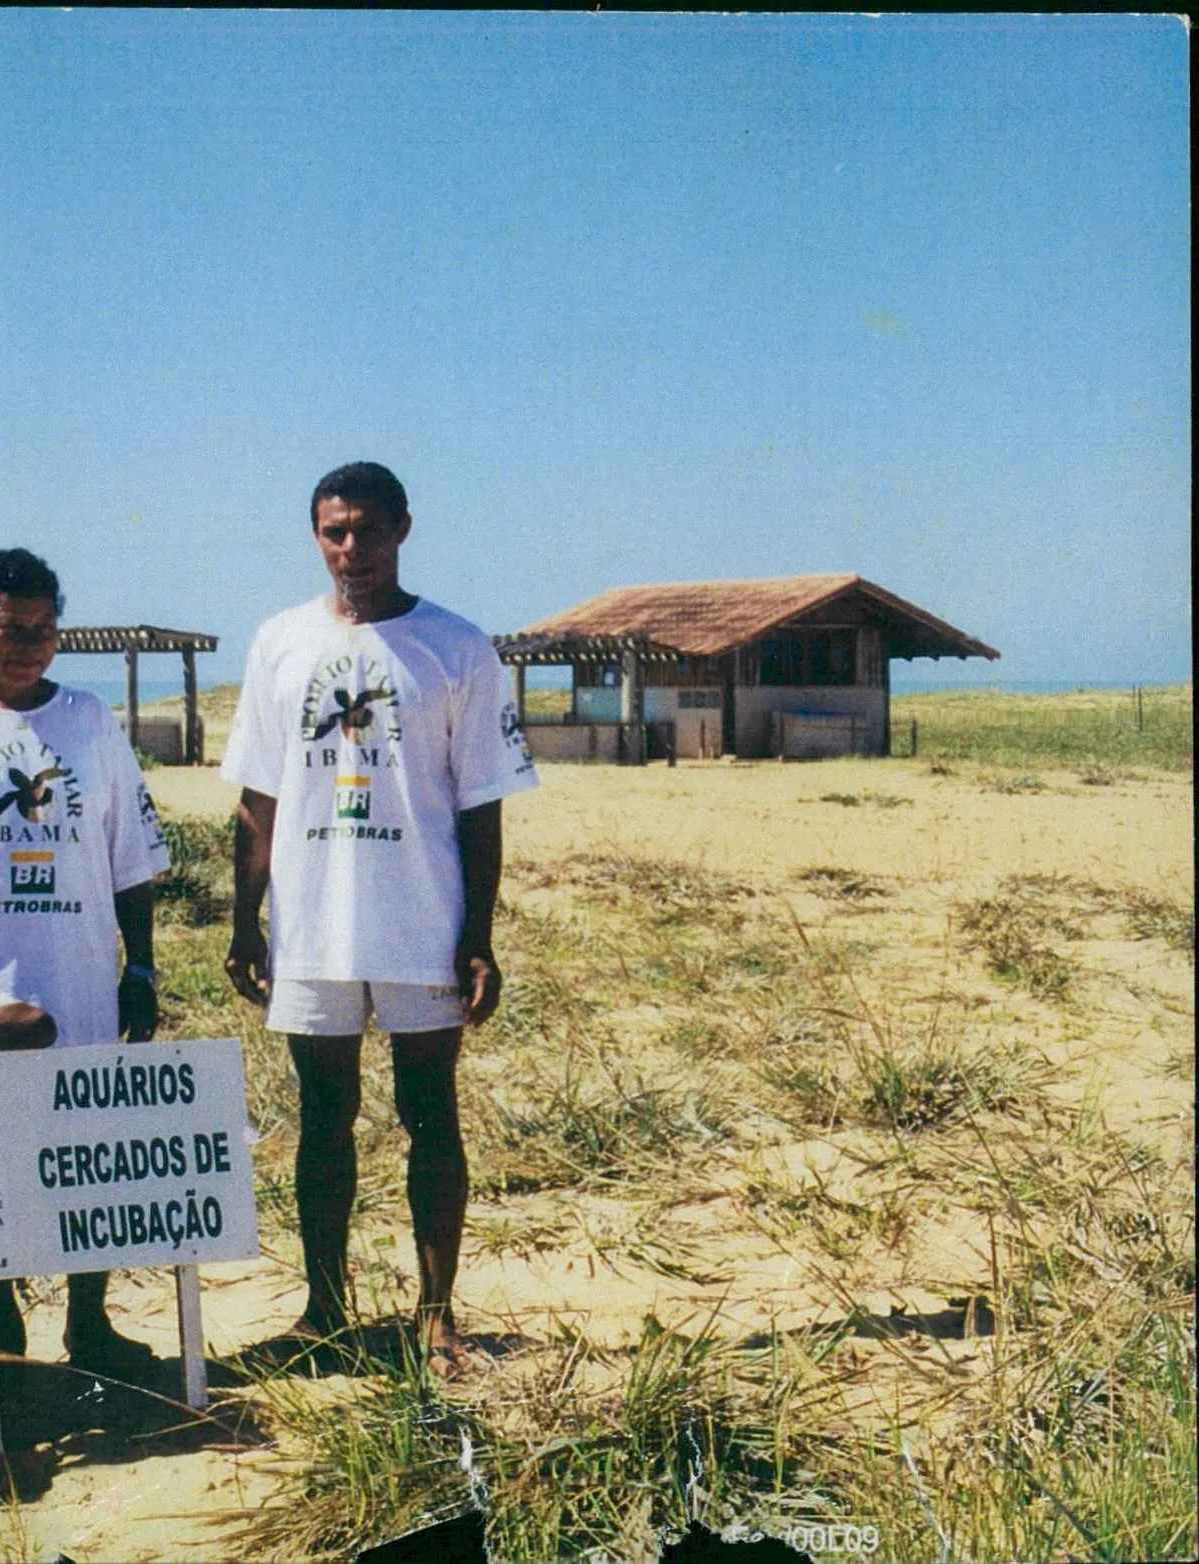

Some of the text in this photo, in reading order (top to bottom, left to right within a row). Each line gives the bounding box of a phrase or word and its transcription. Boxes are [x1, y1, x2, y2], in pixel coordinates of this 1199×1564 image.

[13, 866, 53, 887] BR
[53, 1056, 195, 1111] AQUÁRIOS
[38, 1132, 231, 1189] CERCADOS DE
[58, 1189, 223, 1253] INCUBAÇÃO
